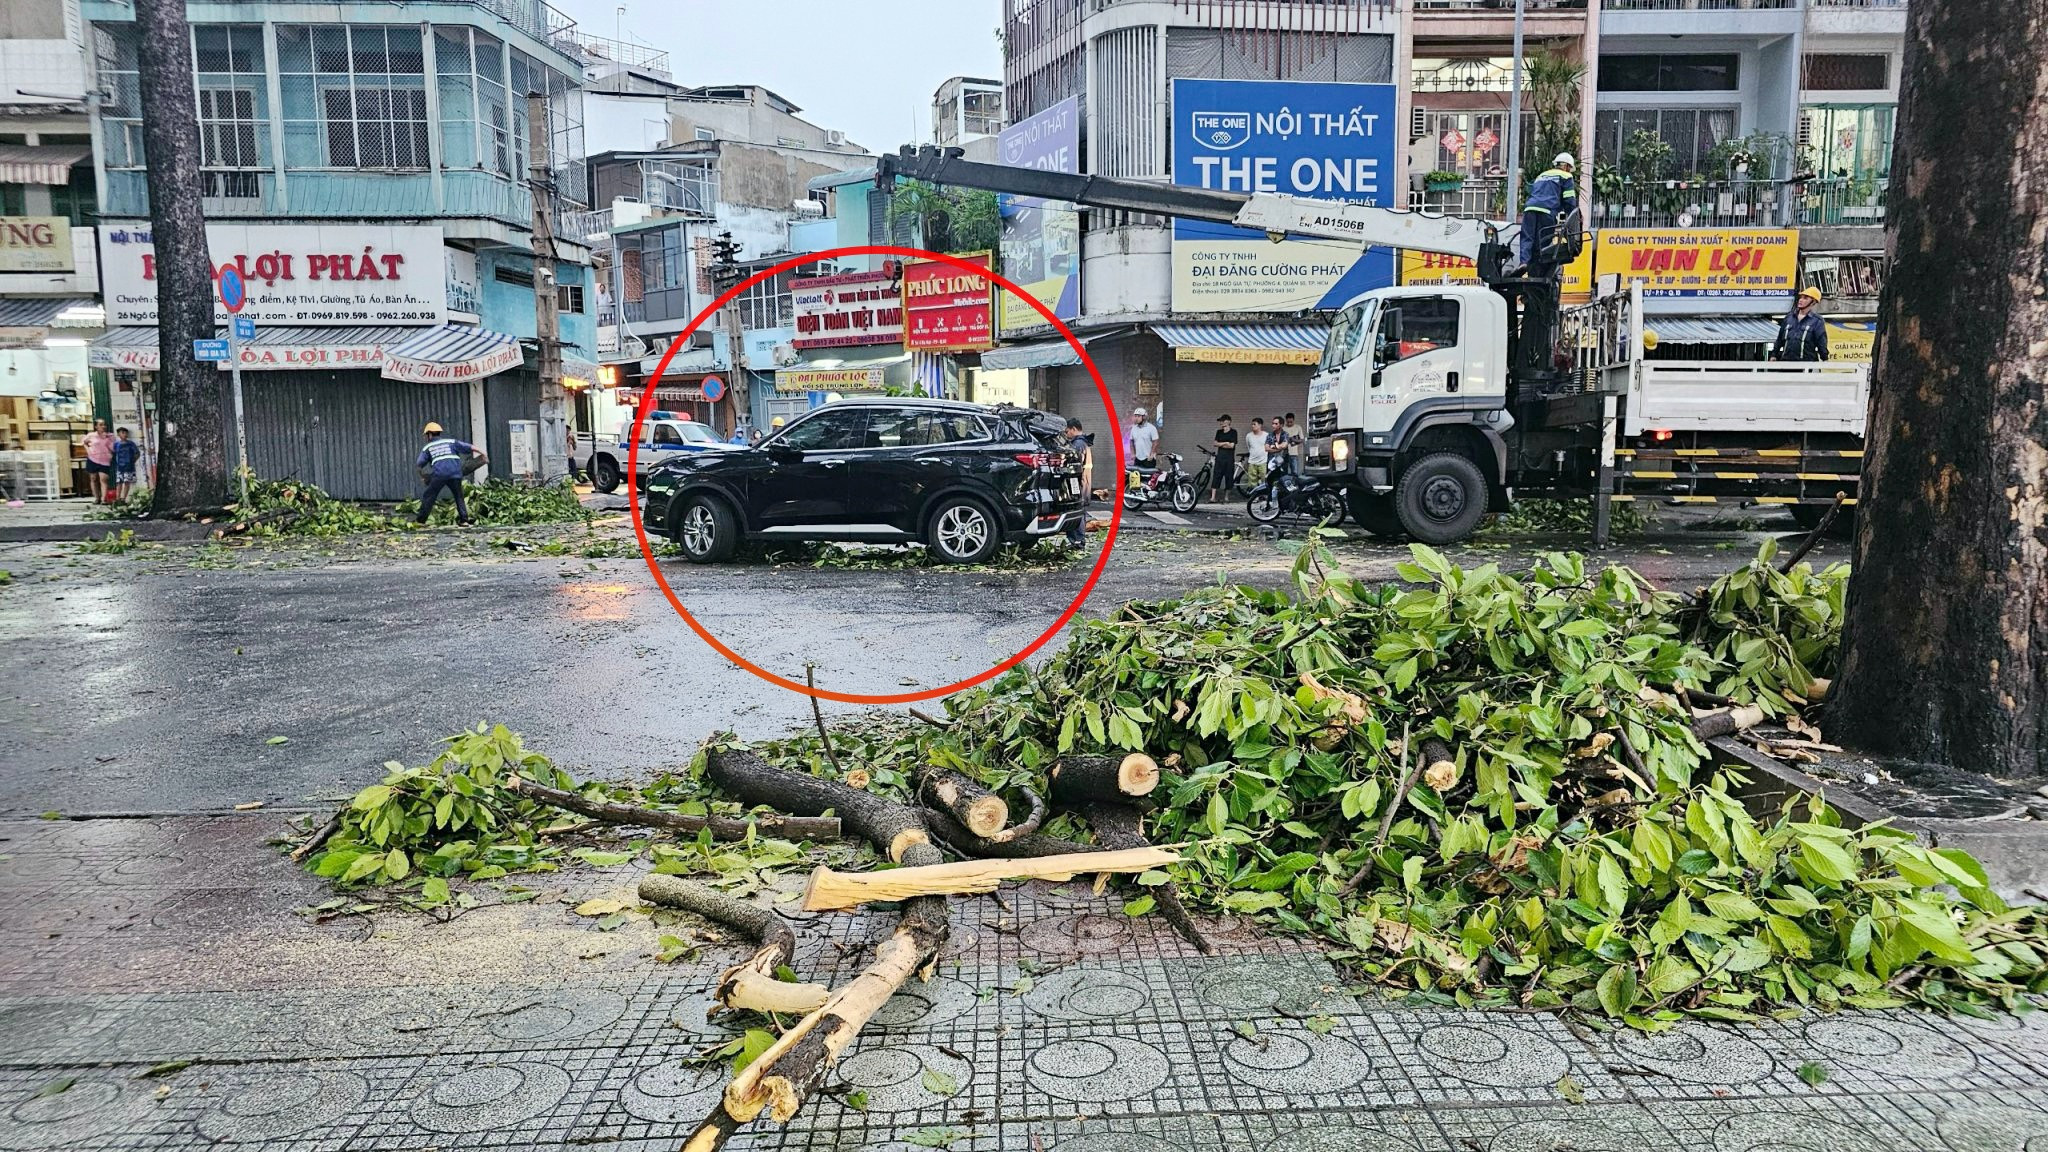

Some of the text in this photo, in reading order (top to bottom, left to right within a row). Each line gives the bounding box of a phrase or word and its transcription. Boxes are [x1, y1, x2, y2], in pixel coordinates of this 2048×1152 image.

[1024, 108, 1068, 146] NỘI THẤT
[1197, 117, 1246, 129] THE ONE
[1256, 106, 1378, 141] NỘI THẤT
[1192, 156, 1378, 193] THE ONE
[1314, 216, 1364, 230] AD1506B
[1608, 233, 1788, 245] CÔNG TY TNHH SẢN XUẤT KINH DOANH
[1191, 251, 1257, 261] CÔNG TY TNHH
[1631, 246, 1765, 275] VẠN LỢI
[234, 250, 295, 287] LỢI
[307, 245, 404, 281] PHÁT
[1192, 262, 1346, 280] ĐẠI ĐĂNG CƯỜNG PHÁT
[907, 273, 945, 297] PHÚC
[946, 274, 986, 294] LONG
[386, 295, 402, 304] Bàn
[118, 312, 128, 320] 26
[130, 312, 147, 321] Ngô
[376, 312, 436, 320] 0962.260.938
[851, 305, 874, 331] VIỆT
[877, 308, 903, 327] NAM
[286, 346, 326, 367] LỢI
[335, 344, 385, 362] PHÁ
[1201, 348, 1252, 360] CHUYÊN
[385, 359, 413, 377] Nội
[418, 363, 451, 378] Thất
[453, 360, 480, 378] HÒA
[482, 357, 497, 374] LỢI
